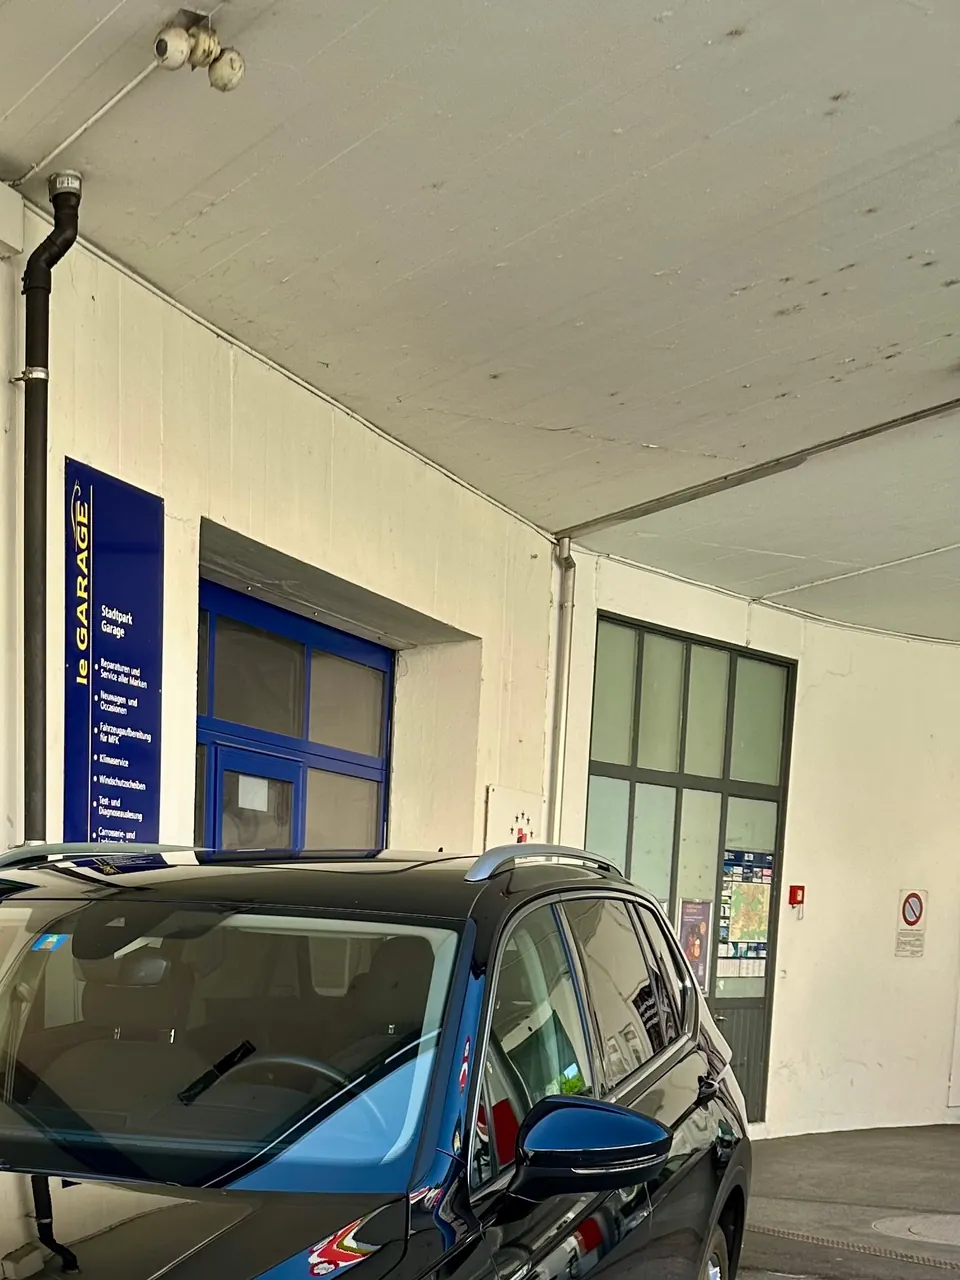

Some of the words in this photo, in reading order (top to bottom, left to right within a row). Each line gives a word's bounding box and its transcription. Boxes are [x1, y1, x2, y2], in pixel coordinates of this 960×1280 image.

[76, 500, 88, 651] GARAGE
[101, 604, 133, 625] Stadtpark
[101, 620, 125, 639] Garage
[76, 658, 88, 685] le
[100, 657, 130, 674] Reparaturen
[130, 668, 141, 677] und
[100, 668, 117, 681] Service
[100, 690, 126, 705] Neuwagen
[128, 698, 138, 707] und
[108, 734, 120, 745] MFK
[100, 753, 129, 768] Klimaservice
[99, 775, 146, 791] Windschutzscheiben
[111, 797, 121, 807] und
